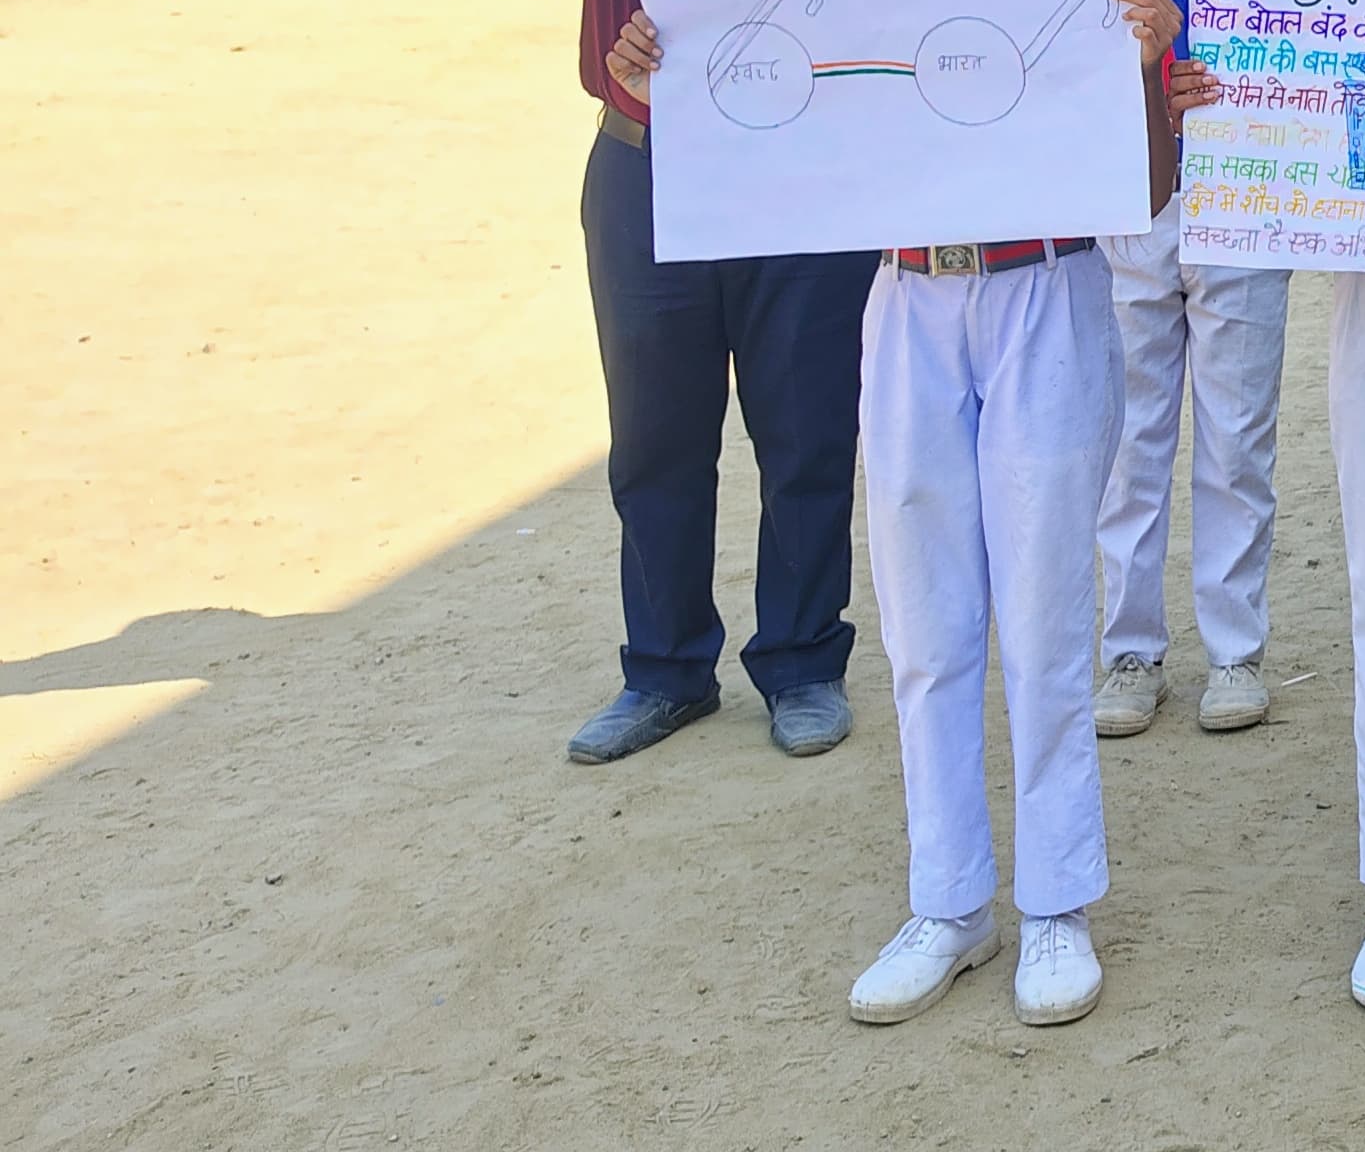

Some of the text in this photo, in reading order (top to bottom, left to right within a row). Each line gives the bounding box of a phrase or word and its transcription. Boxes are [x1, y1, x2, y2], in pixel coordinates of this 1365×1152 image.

[1245, 0, 1302, 35] बोतल
[1311, 5, 1348, 41] बंद
[1270, 39, 1297, 73] की
[1304, 50, 1339, 76] बस
[1267, 76, 1287, 109] से
[1288, 88, 1328, 114] नाता
[1184, 153, 1214, 178] हम
[1284, 161, 1319, 187] बस
[1284, 188, 1308, 219] को
[1183, 224, 1261, 253] स्वच्छता
[1264, 219, 1284, 255] है
[1288, 231, 1327, 255] एक
